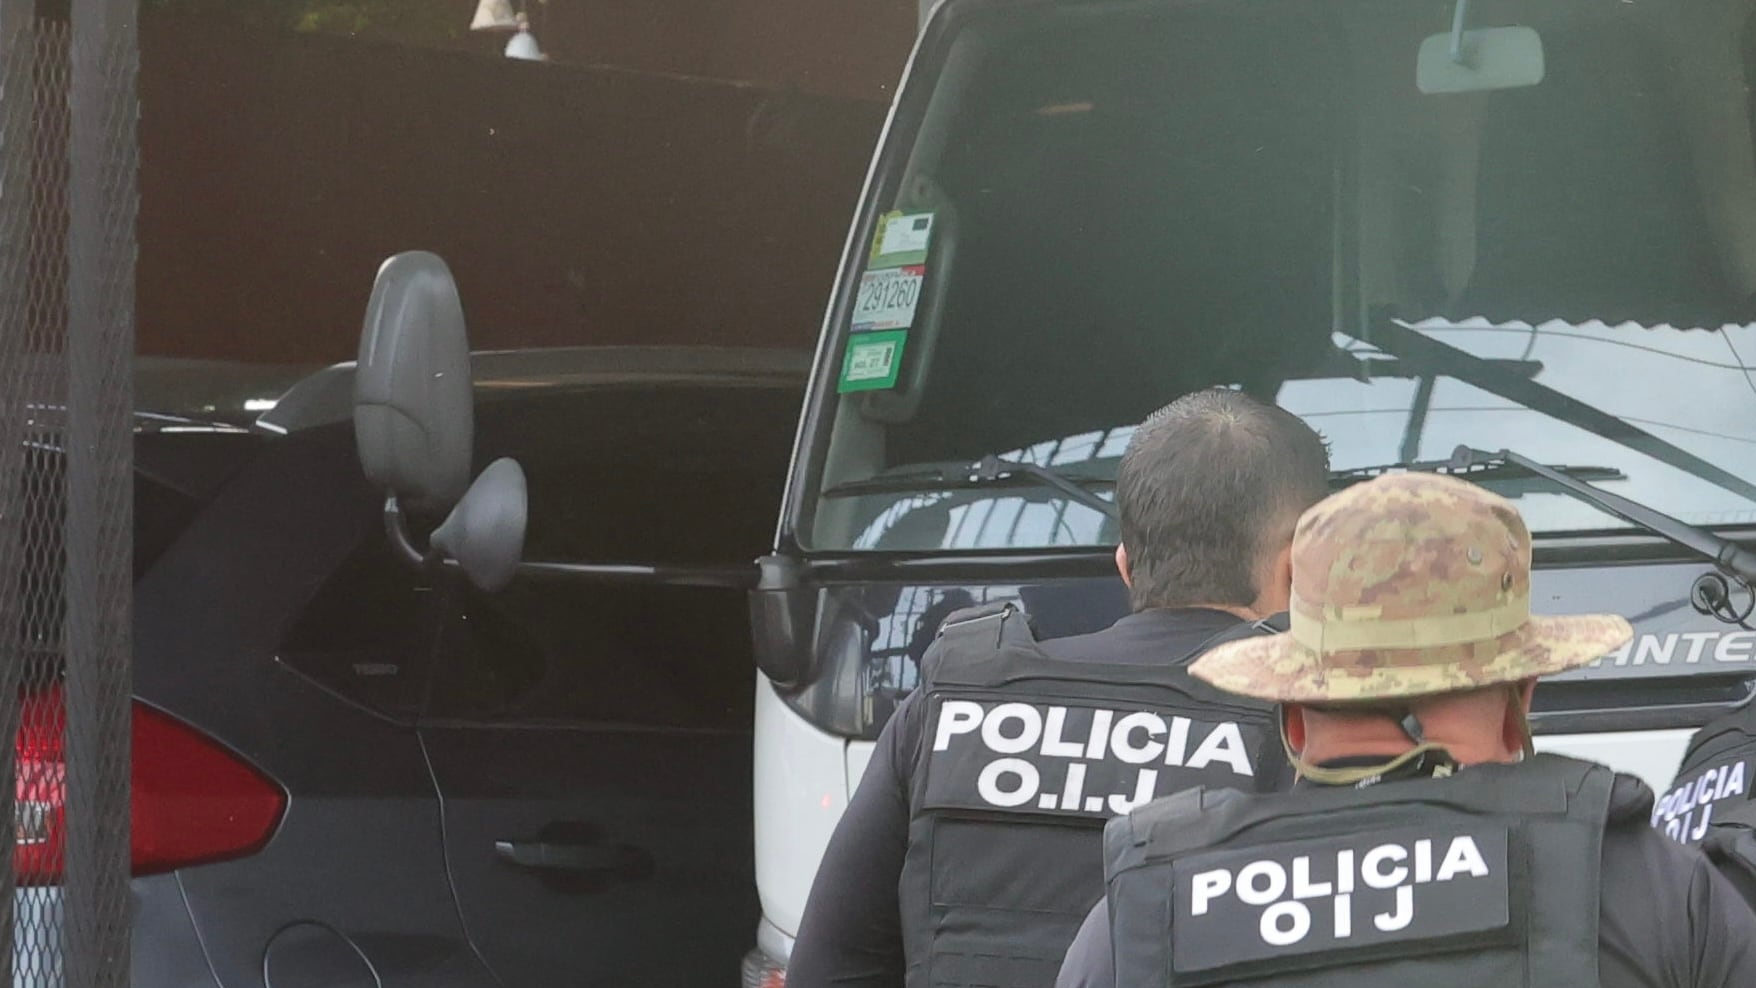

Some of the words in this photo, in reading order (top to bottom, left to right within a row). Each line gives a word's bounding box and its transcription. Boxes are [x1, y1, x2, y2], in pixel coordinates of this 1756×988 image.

[933, 700, 1254, 776] POLICIA
[1651, 761, 1745, 828] POLICIA
[1191, 836, 1489, 916] POLICIA
